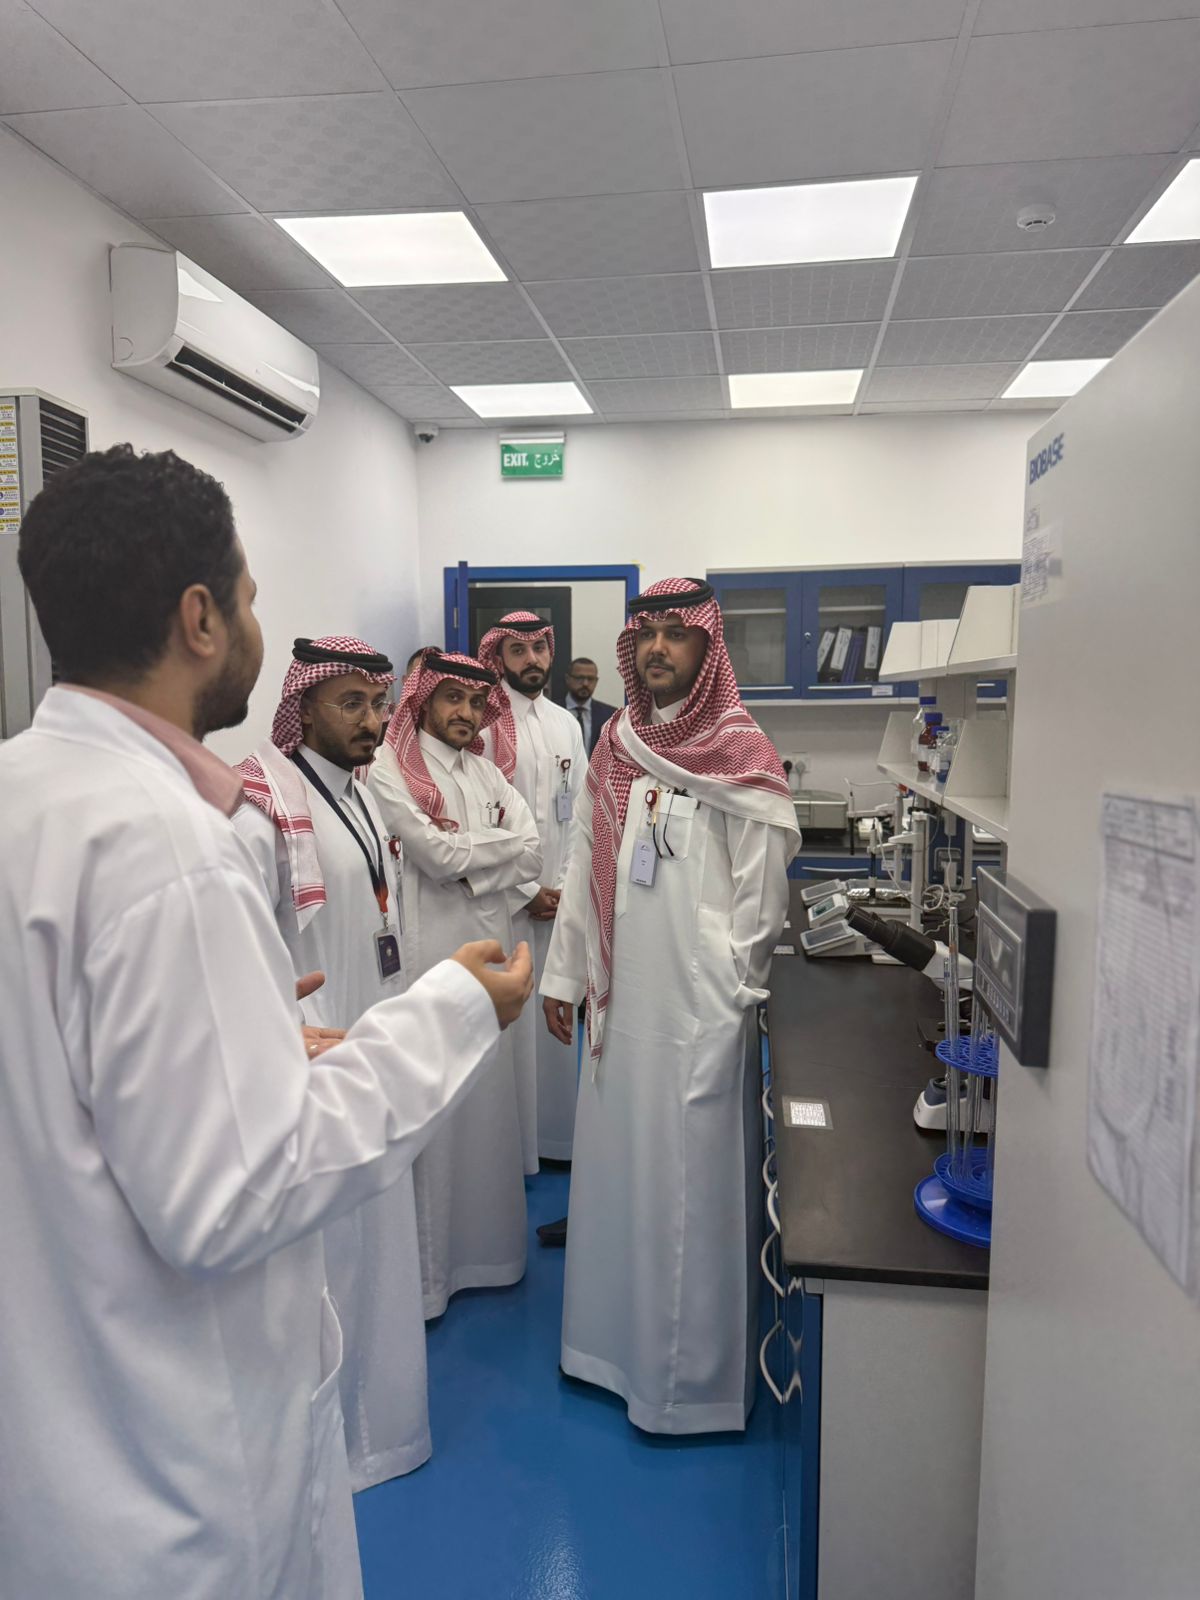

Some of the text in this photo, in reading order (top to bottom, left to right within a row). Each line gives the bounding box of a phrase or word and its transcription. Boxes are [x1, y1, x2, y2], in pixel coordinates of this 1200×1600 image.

[503, 453, 529, 467] EXIT
[534, 449, 560, 468] خروج
[1029, 432, 1064, 485] BIOBASE
